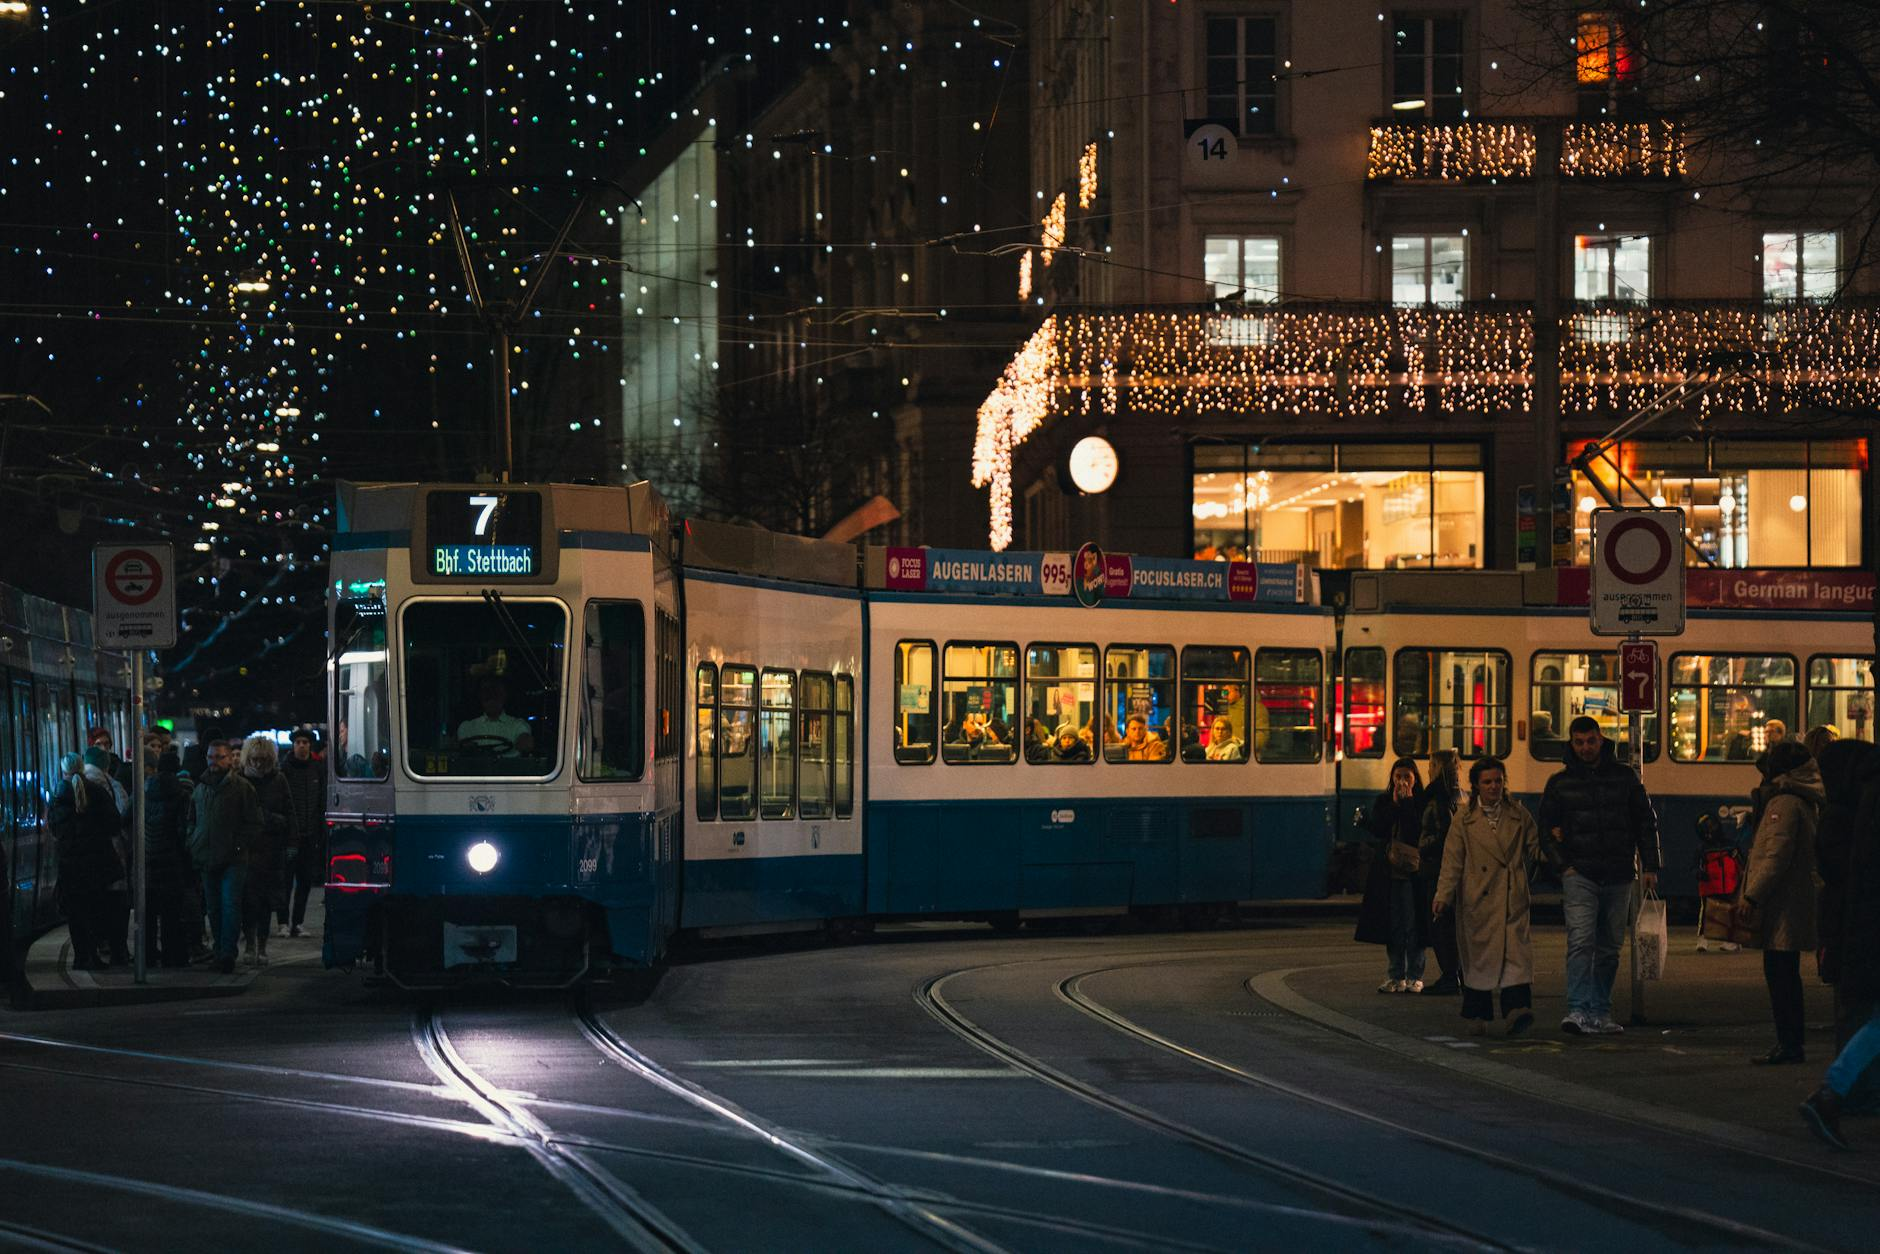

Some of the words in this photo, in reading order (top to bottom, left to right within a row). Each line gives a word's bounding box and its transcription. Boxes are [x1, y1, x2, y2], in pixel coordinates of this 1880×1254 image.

[1197, 137, 1228, 160] 14
[469, 496, 498, 536] 7
[436, 548, 463, 573] Bhf.
[467, 548, 531, 573] Stettbach
[901, 558, 921, 568] FOCUS
[901, 568, 921, 579] LASER
[932, 560, 1033, 583] AUGENLASERN
[1133, 569, 1222, 589] FOCUSLASER.CH
[1734, 580, 1808, 599] German
[579, 858, 597, 873] 2099
